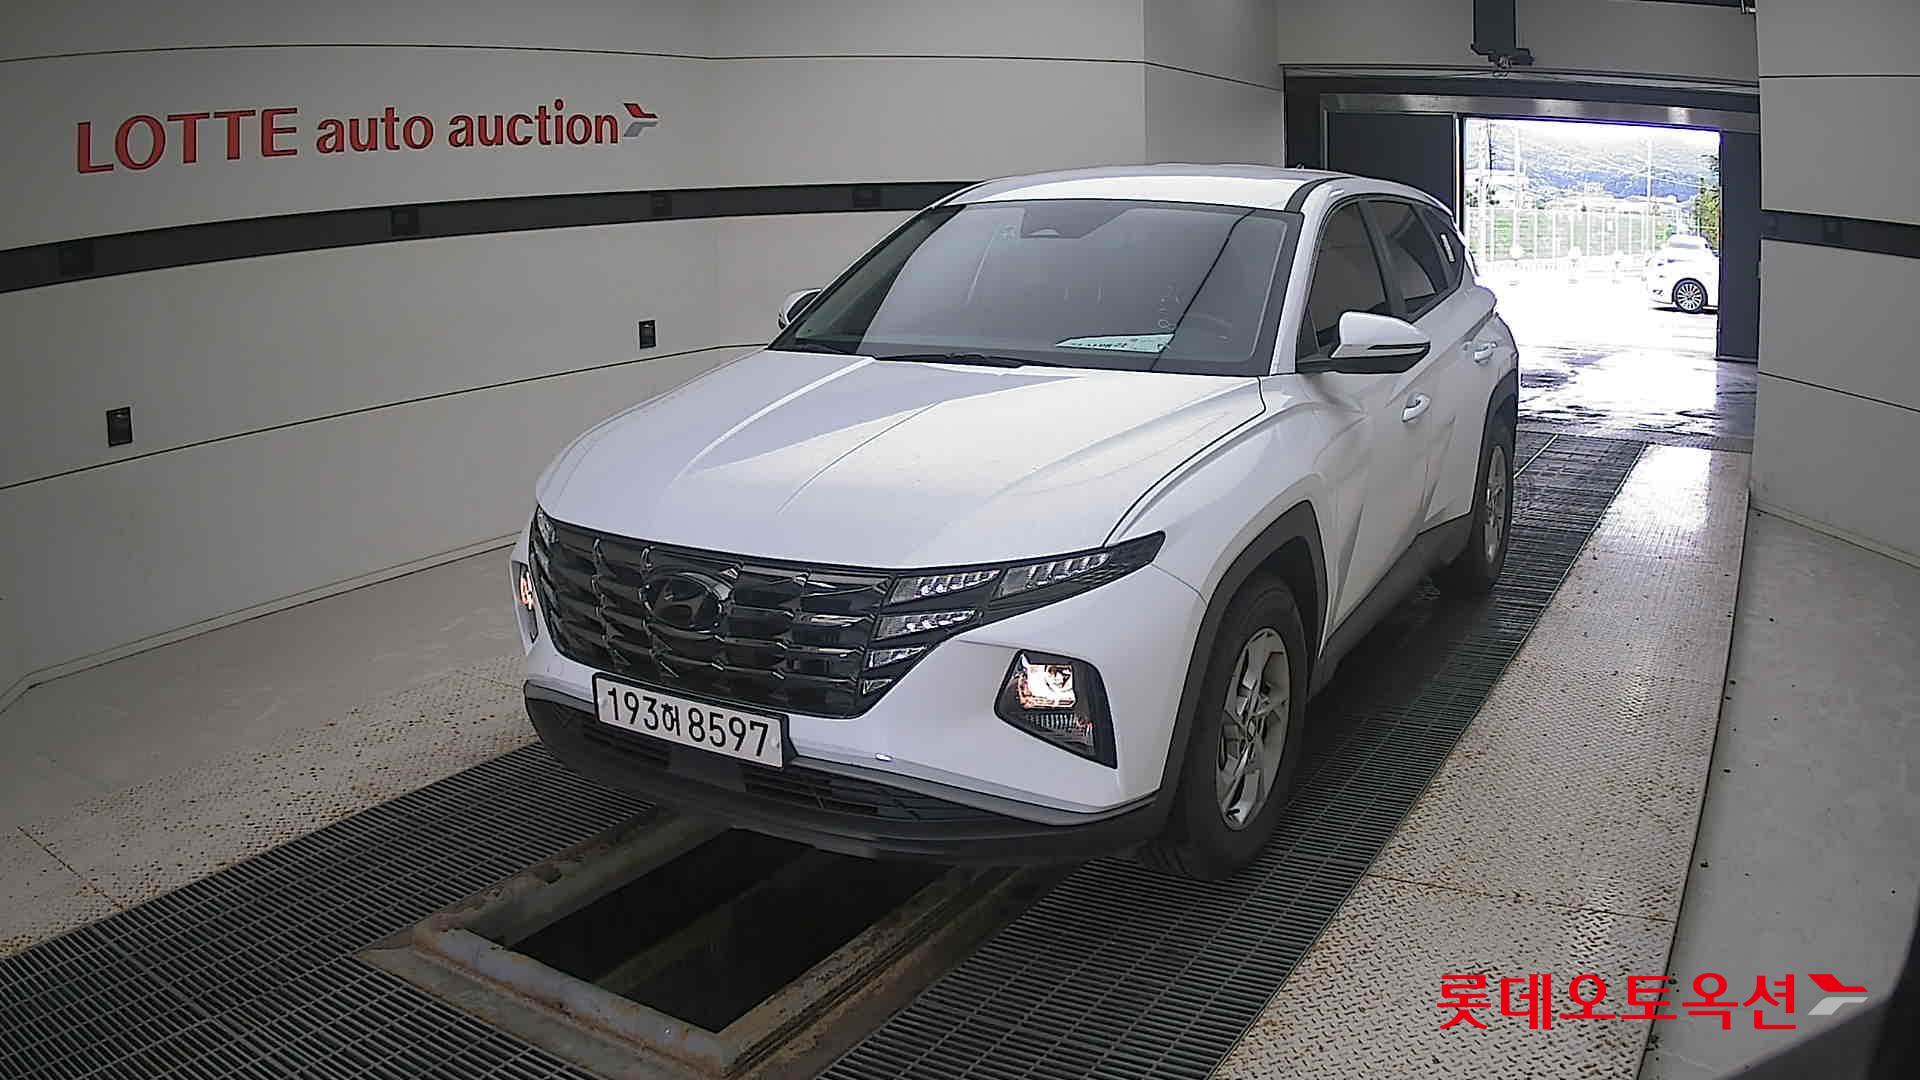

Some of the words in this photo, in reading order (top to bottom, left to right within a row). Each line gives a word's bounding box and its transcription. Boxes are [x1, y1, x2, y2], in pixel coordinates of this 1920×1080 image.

[77, 106, 298, 174] LOTTE
[316, 107, 434, 154] auto
[447, 99, 619, 148] auction
[688, 707, 769, 757] 8597
